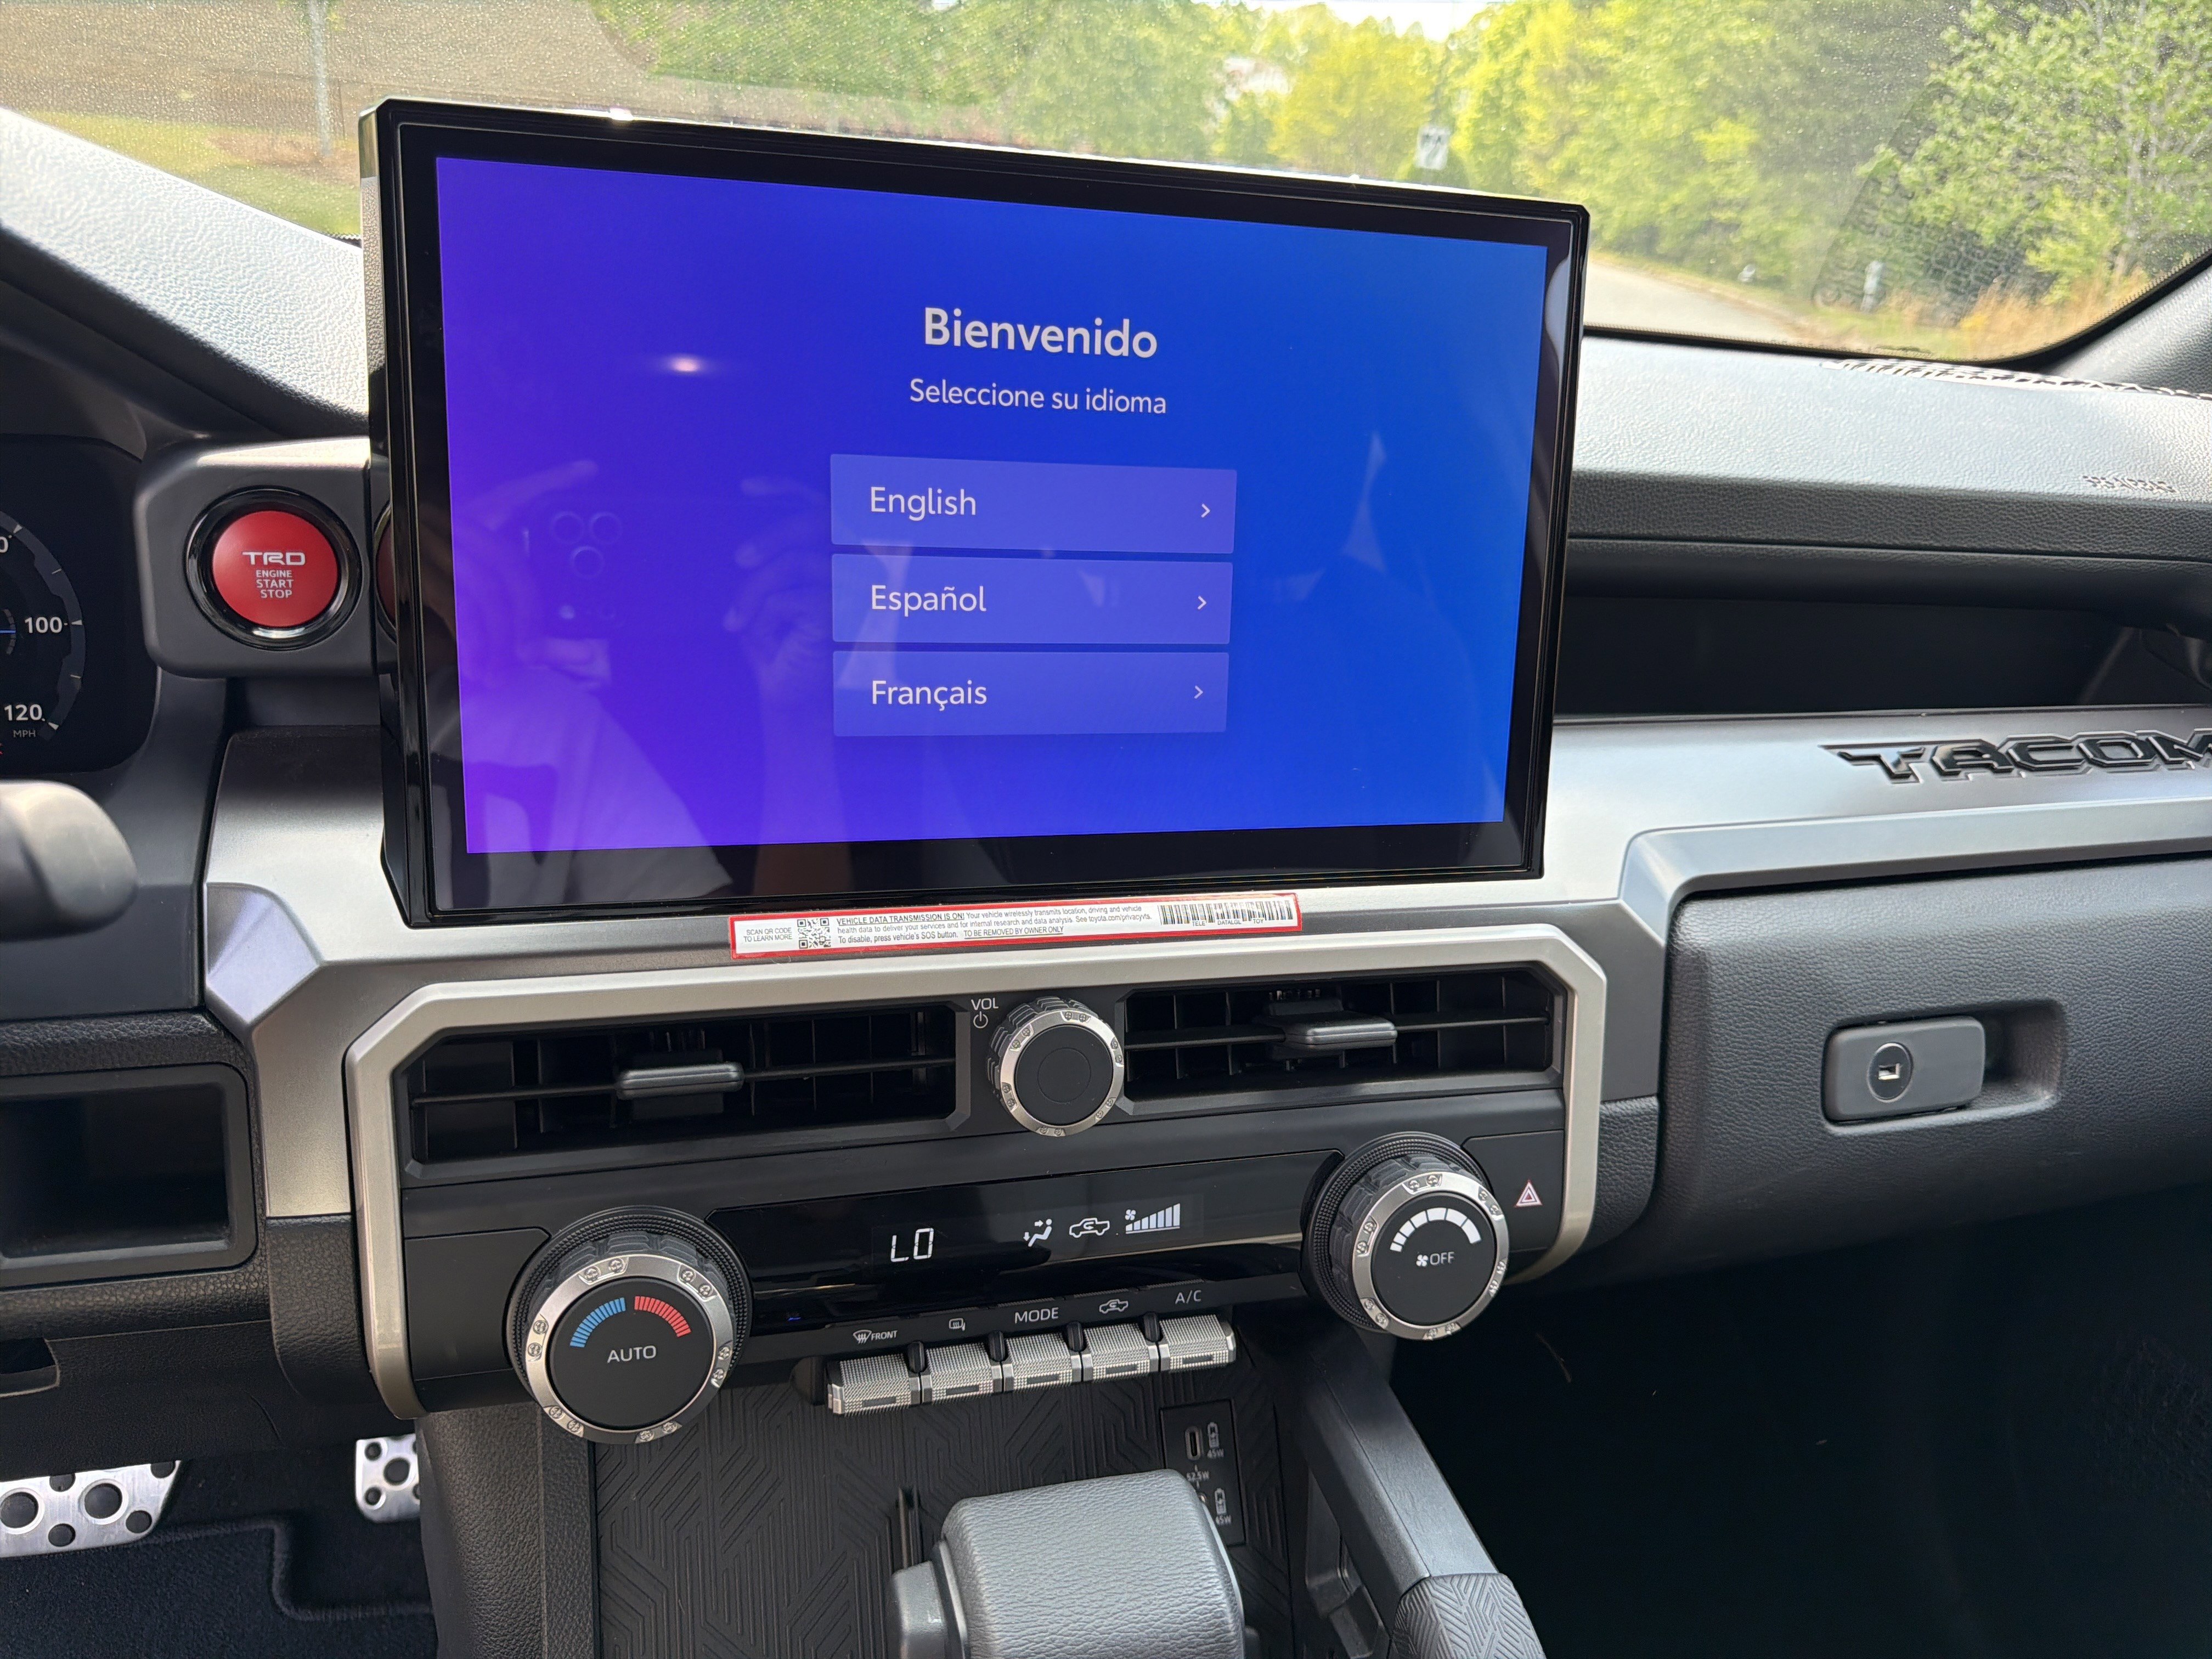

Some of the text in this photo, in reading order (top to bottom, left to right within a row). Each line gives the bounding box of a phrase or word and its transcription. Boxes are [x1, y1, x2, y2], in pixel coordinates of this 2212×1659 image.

[924, 307, 1158, 358] Bienvenido
[910, 377, 1166, 414] Seleccione su idioma
[870, 485, 977, 521] English
[242, 552, 306, 566] TRD
[256, 569, 292, 578] ENGINE
[256, 579, 294, 588] START
[260, 589, 292, 599] STOP
[871, 584, 987, 617] Español
[24, 617, 63, 634] 100
[871, 679, 988, 712] Français
[4, 704, 42, 721] 120
[837, 917, 867, 925] VEHICLE
[889, 913, 942, 923] TRANSMISSION
[837, 926, 857, 934] health
[848, 934, 872, 944] disable,
[874, 935, 891, 944] press
[893, 932, 919, 941] vehicle's
[970, 997, 998, 1011] VOL
[1430, 1251, 1454, 1265] OFF
[1175, 1290, 1202, 1304] A/C
[1014, 1307, 1059, 1324] MODE
[871, 1330, 898, 1341] FRONT
[607, 1345, 657, 1363] AUTO
